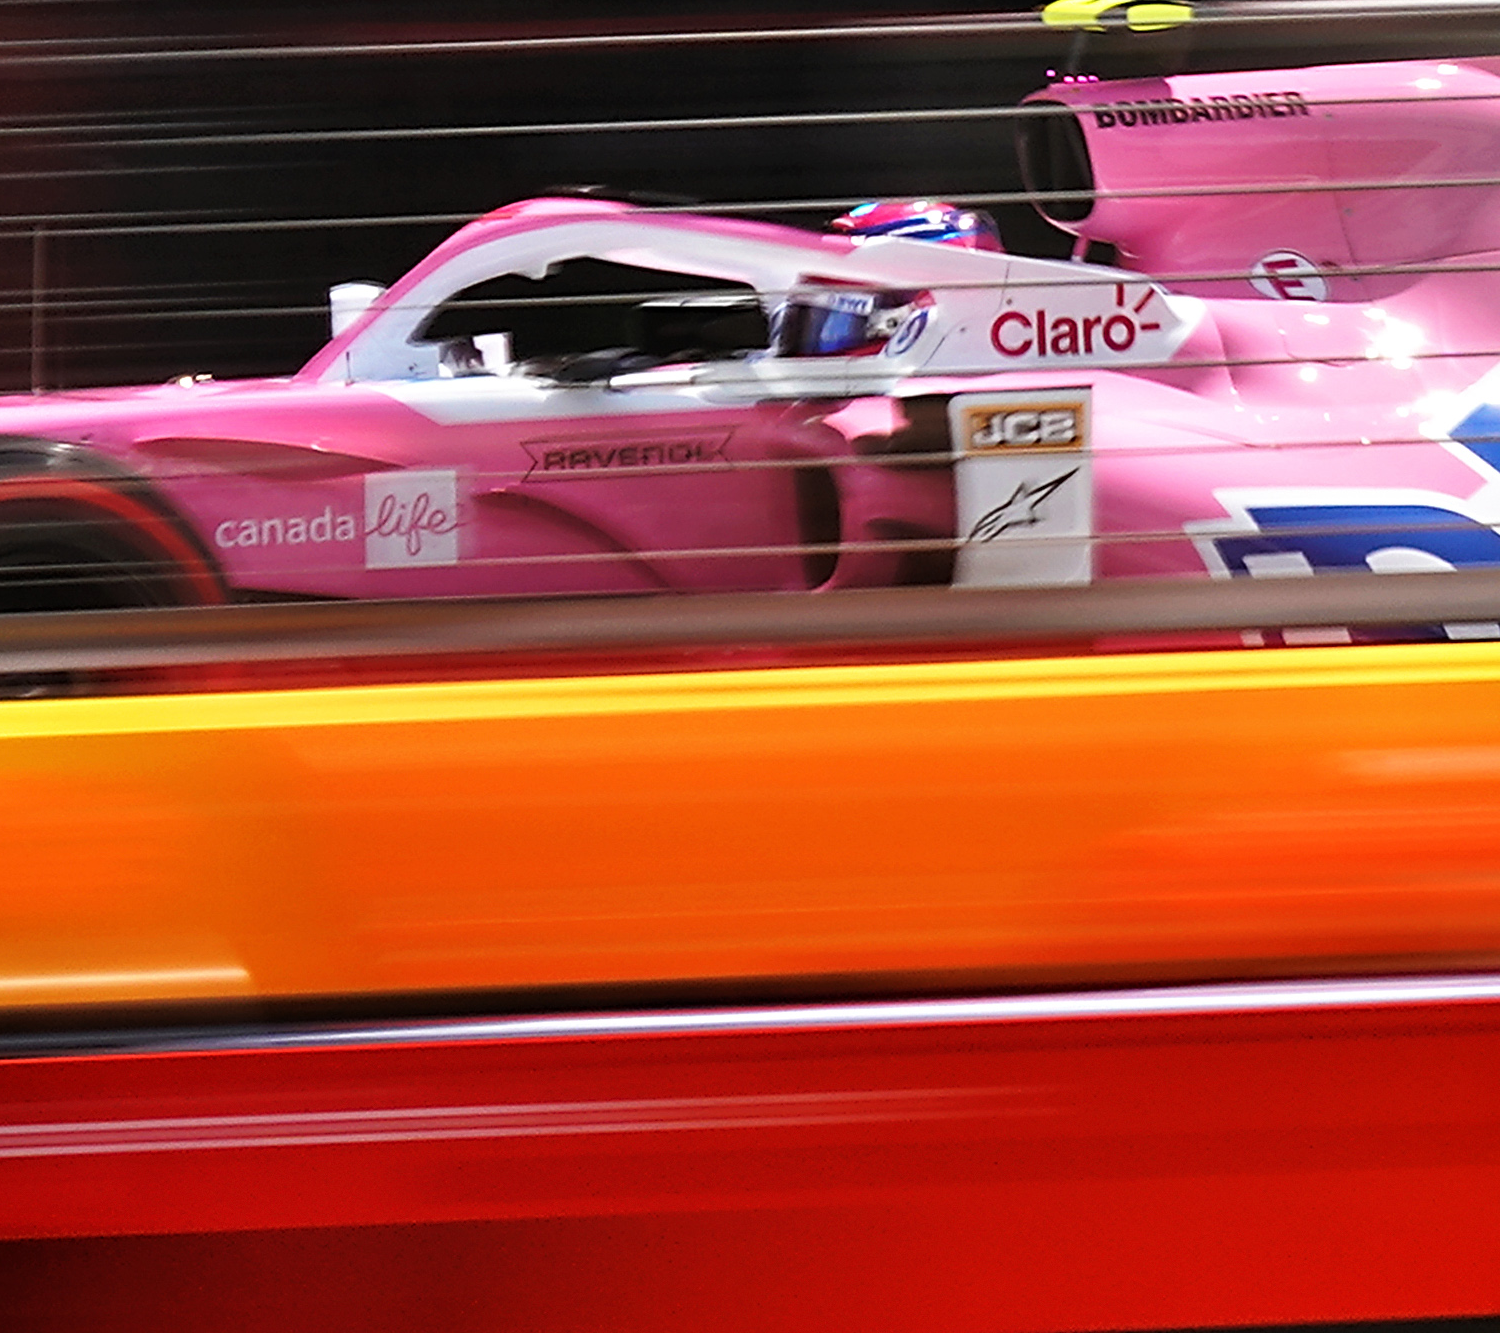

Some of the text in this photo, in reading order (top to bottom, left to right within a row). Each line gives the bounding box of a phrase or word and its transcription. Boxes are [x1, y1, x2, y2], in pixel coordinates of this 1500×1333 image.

[1095, 90, 1308, 130] BOMBARDIER
[990, 309, 1136, 358] Claro
[971, 410, 1077, 447] JCB
[214, 492, 468, 557] canada life
